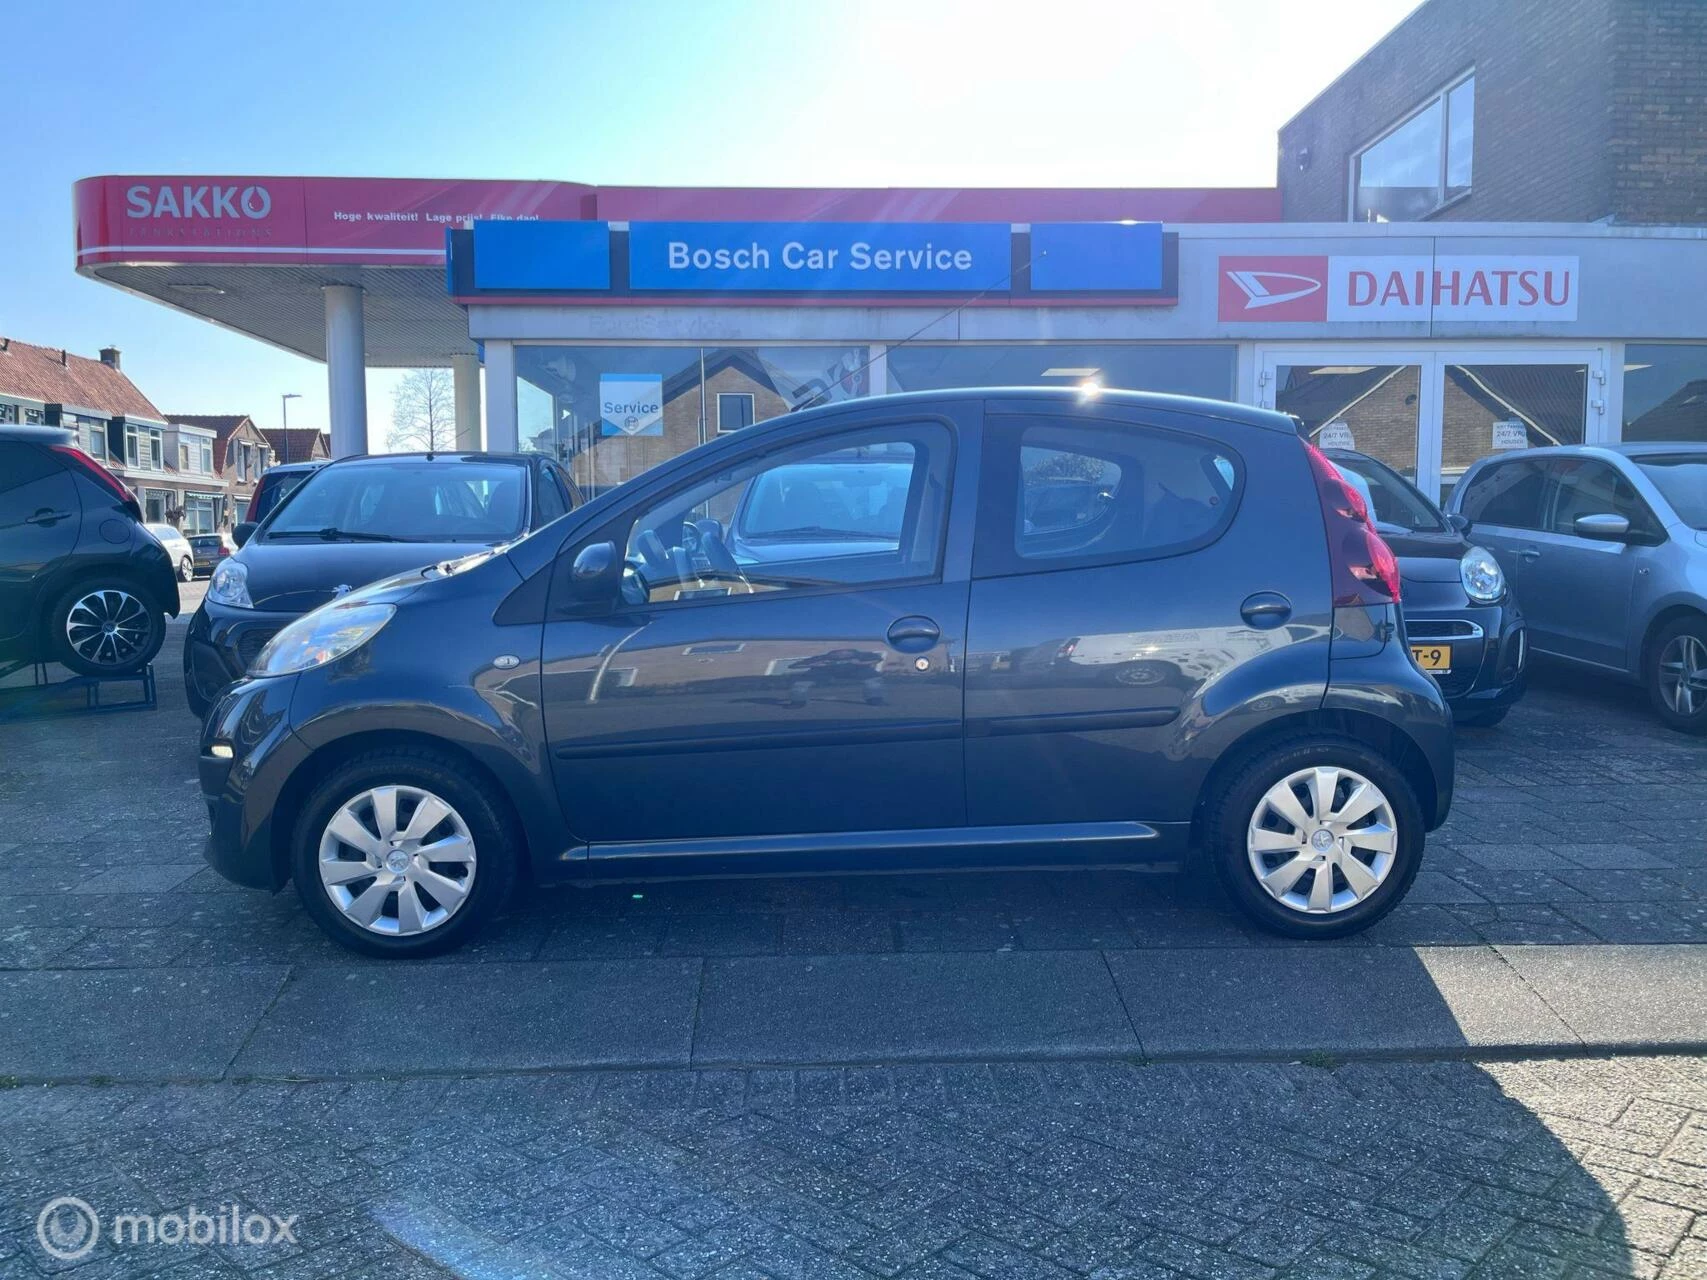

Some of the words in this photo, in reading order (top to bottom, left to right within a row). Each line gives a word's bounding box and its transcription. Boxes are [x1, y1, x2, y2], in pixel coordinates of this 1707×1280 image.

[126, 185, 271, 219] SAKKO
[334, 211, 362, 222] Hoge
[367, 211, 419, 221] kwaliteit!
[426, 212, 452, 223] Lage
[668, 242, 770, 270] Bosch
[782, 242, 838, 270] Car
[849, 242, 973, 270] Service
[1347, 270, 1570, 307] DAIHATSU
[603, 401, 659, 414] Service
